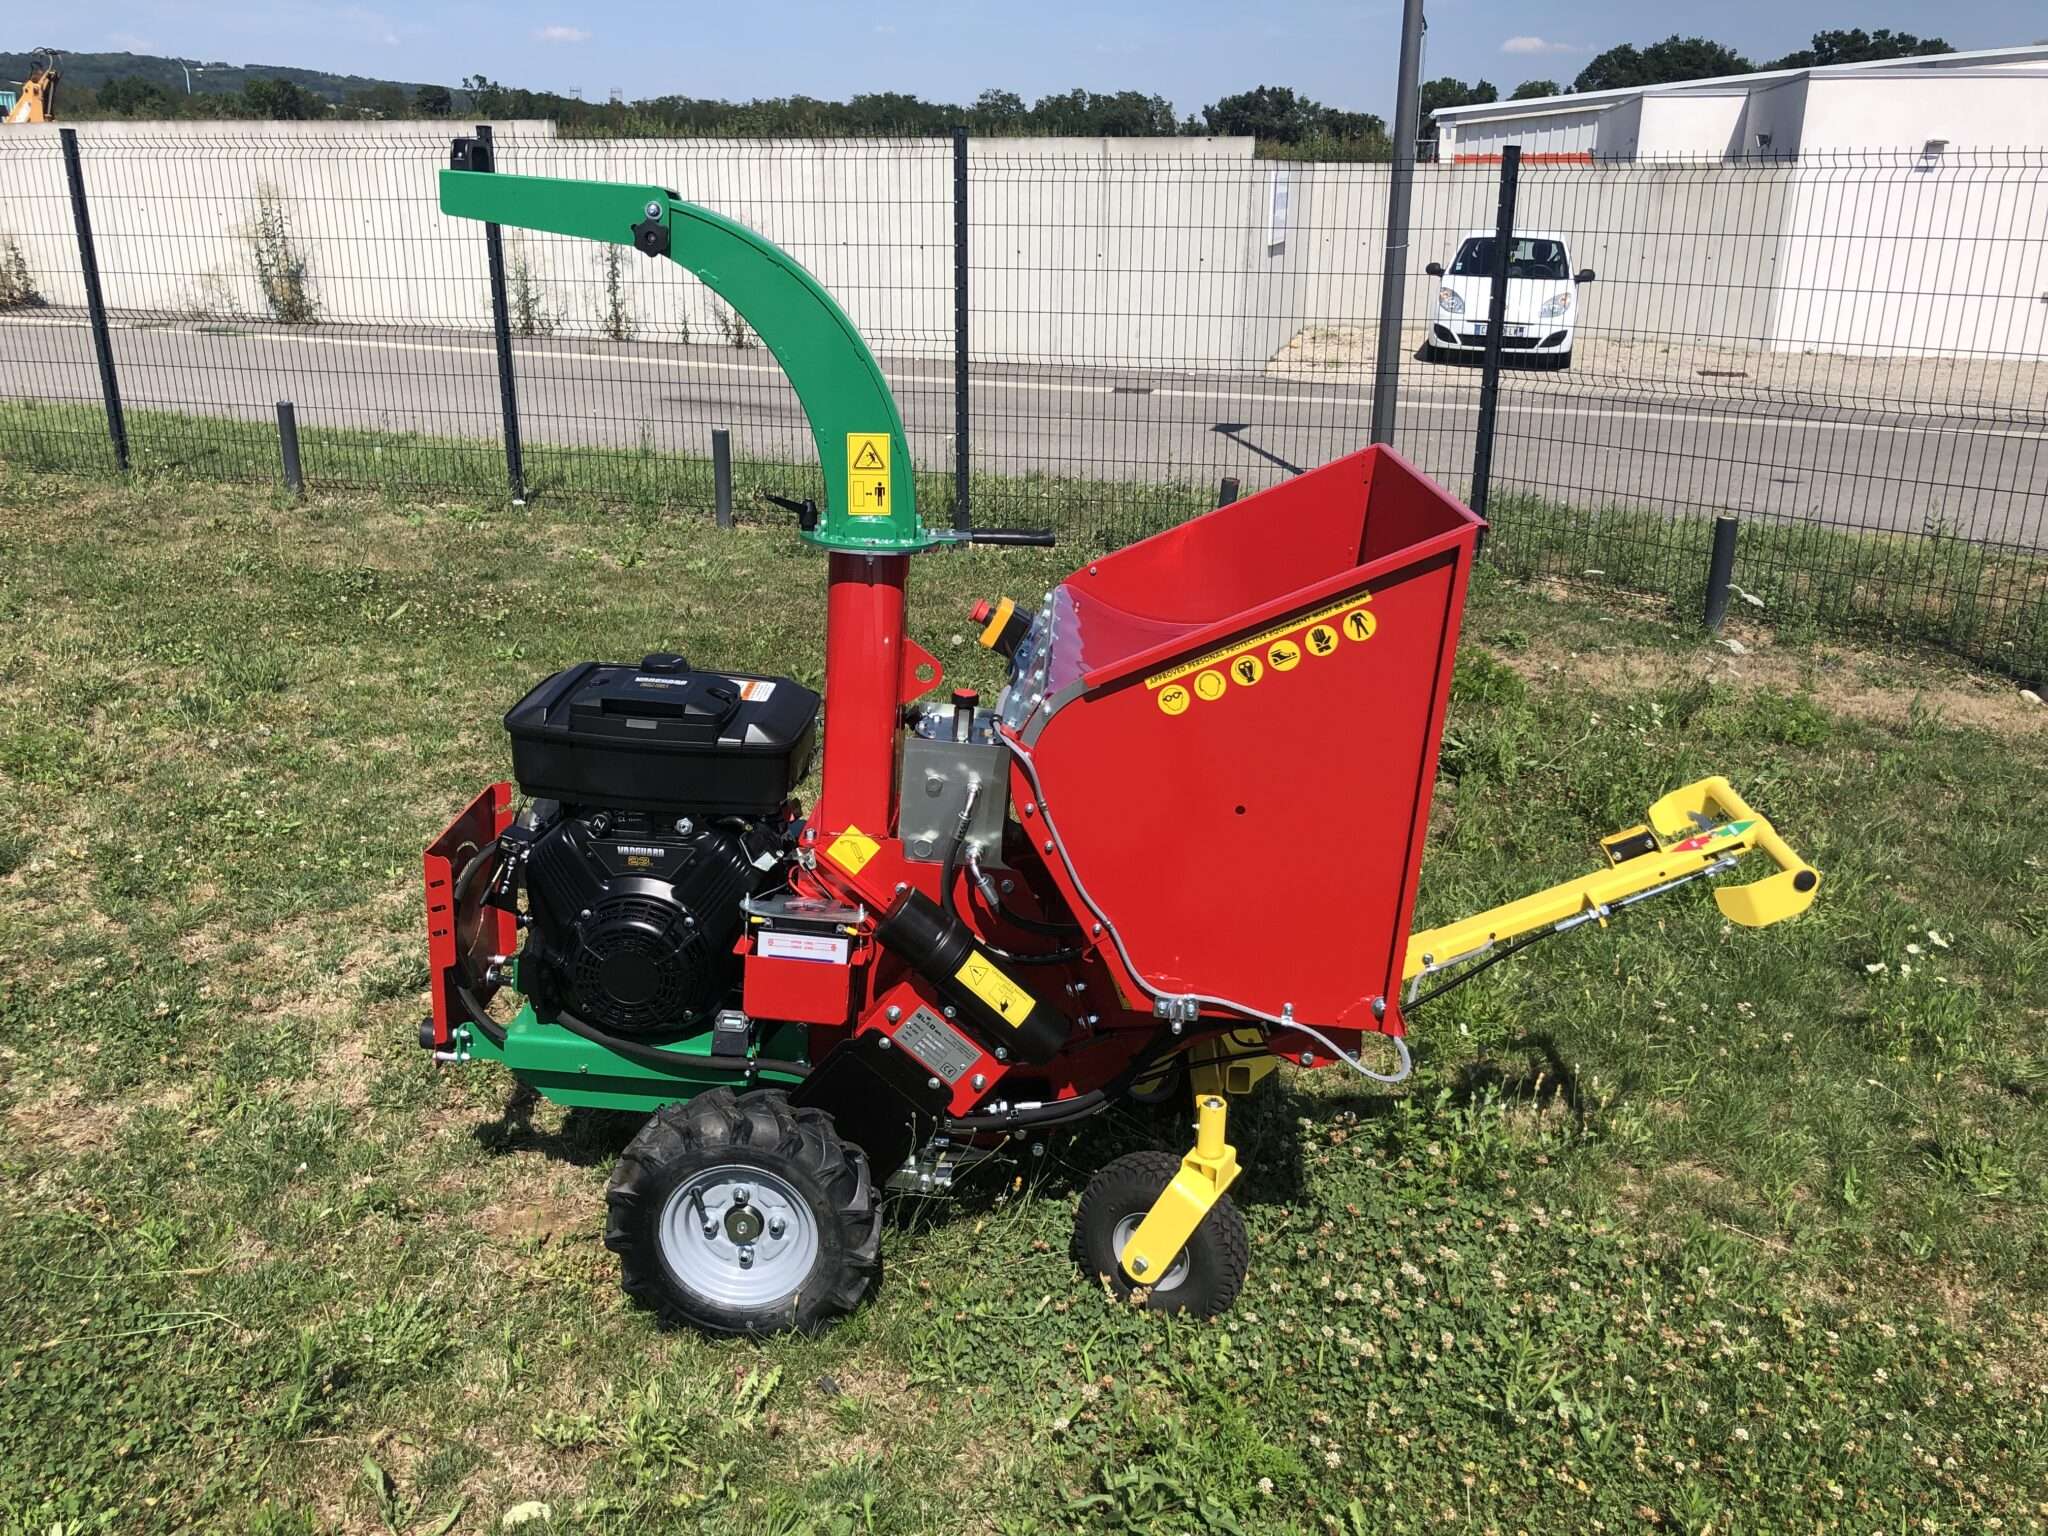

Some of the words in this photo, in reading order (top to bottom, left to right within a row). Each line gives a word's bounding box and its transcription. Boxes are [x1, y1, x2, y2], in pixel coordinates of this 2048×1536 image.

[1149, 666, 1186, 684] APPROVED
[1188, 652, 1224, 668] PERSONAL
[1226, 635, 1266, 652] PROTECTIVE
[1269, 617, 1310, 635] EQUIPMENT
[617, 846, 665, 858] VANGUARD
